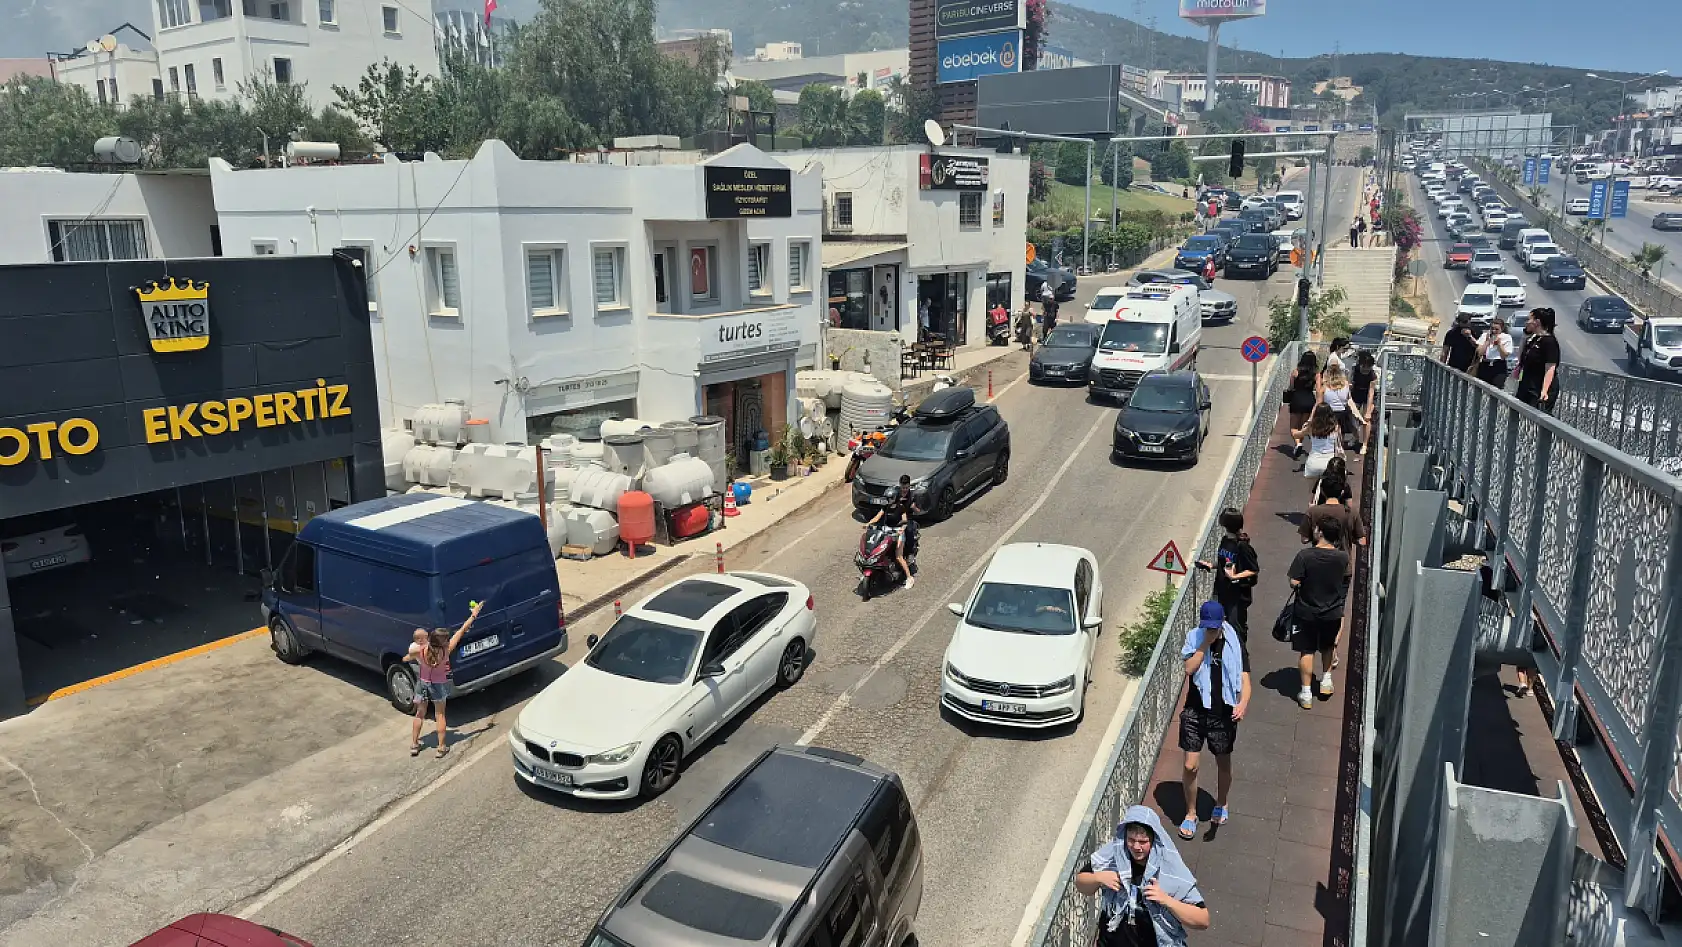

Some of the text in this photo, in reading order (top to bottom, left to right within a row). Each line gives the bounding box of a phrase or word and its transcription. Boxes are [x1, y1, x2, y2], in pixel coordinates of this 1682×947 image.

[970, 2, 1014, 16] CINEVERSE
[942, 46, 998, 69] ebebek
[151, 304, 205, 320] AUTO
[153, 320, 204, 336] KING
[718, 321, 762, 342] turtes
[0, 378, 351, 466] OTO EKSPERTİZ
